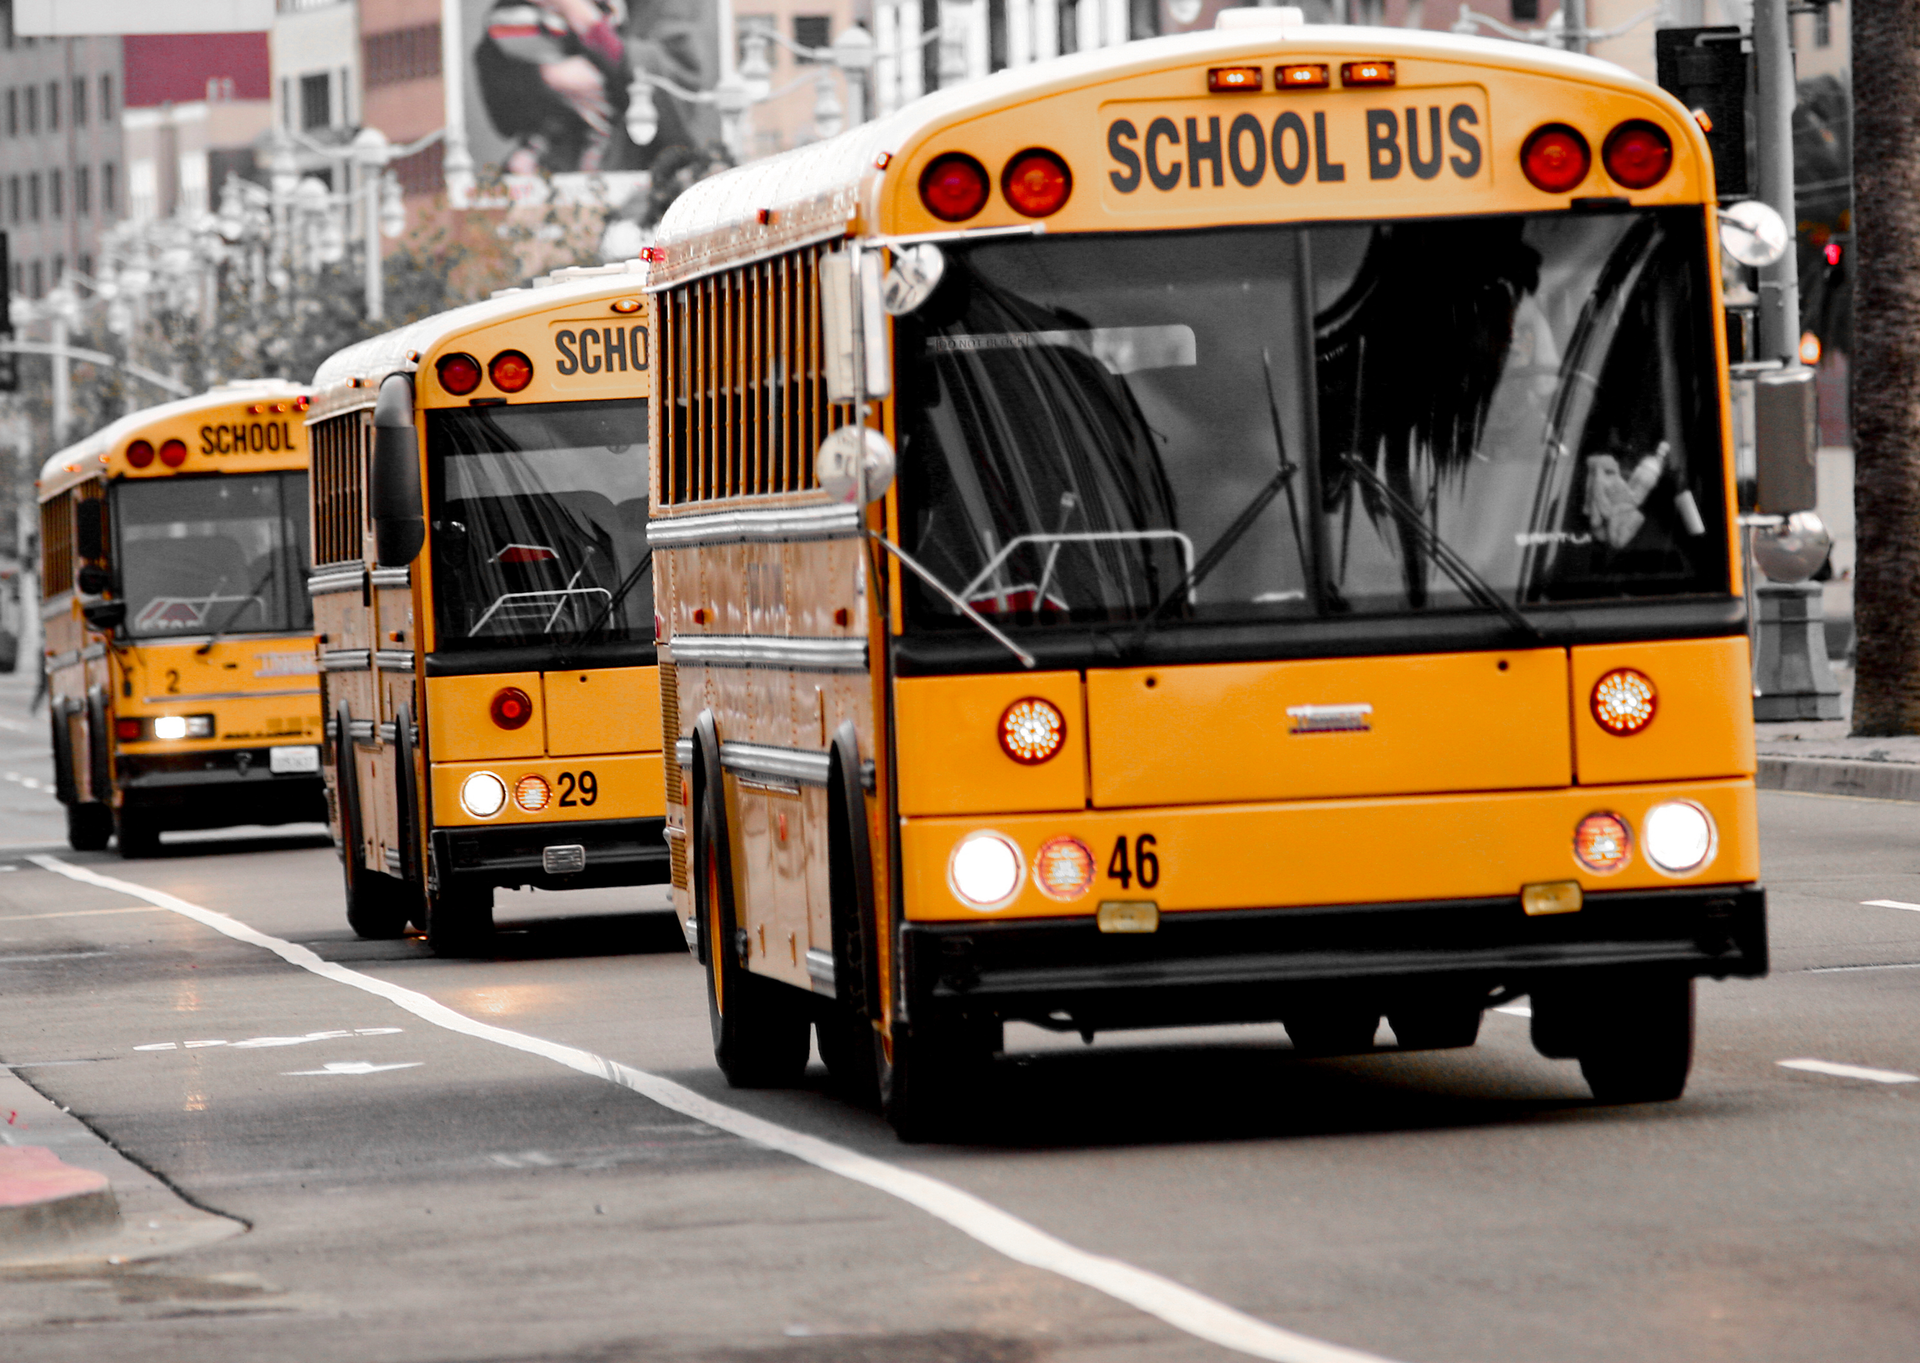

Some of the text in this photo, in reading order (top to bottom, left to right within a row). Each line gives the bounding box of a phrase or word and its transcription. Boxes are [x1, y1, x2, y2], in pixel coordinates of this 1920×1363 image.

[1107, 99, 1482, 195] SCHOOL BUS
[555, 325, 649, 376] SCHO
[200, 421, 296, 455] SCHOOL
[165, 669, 180, 694] 2
[557, 770, 598, 808] 29
[1107, 833, 1160, 890] 46
